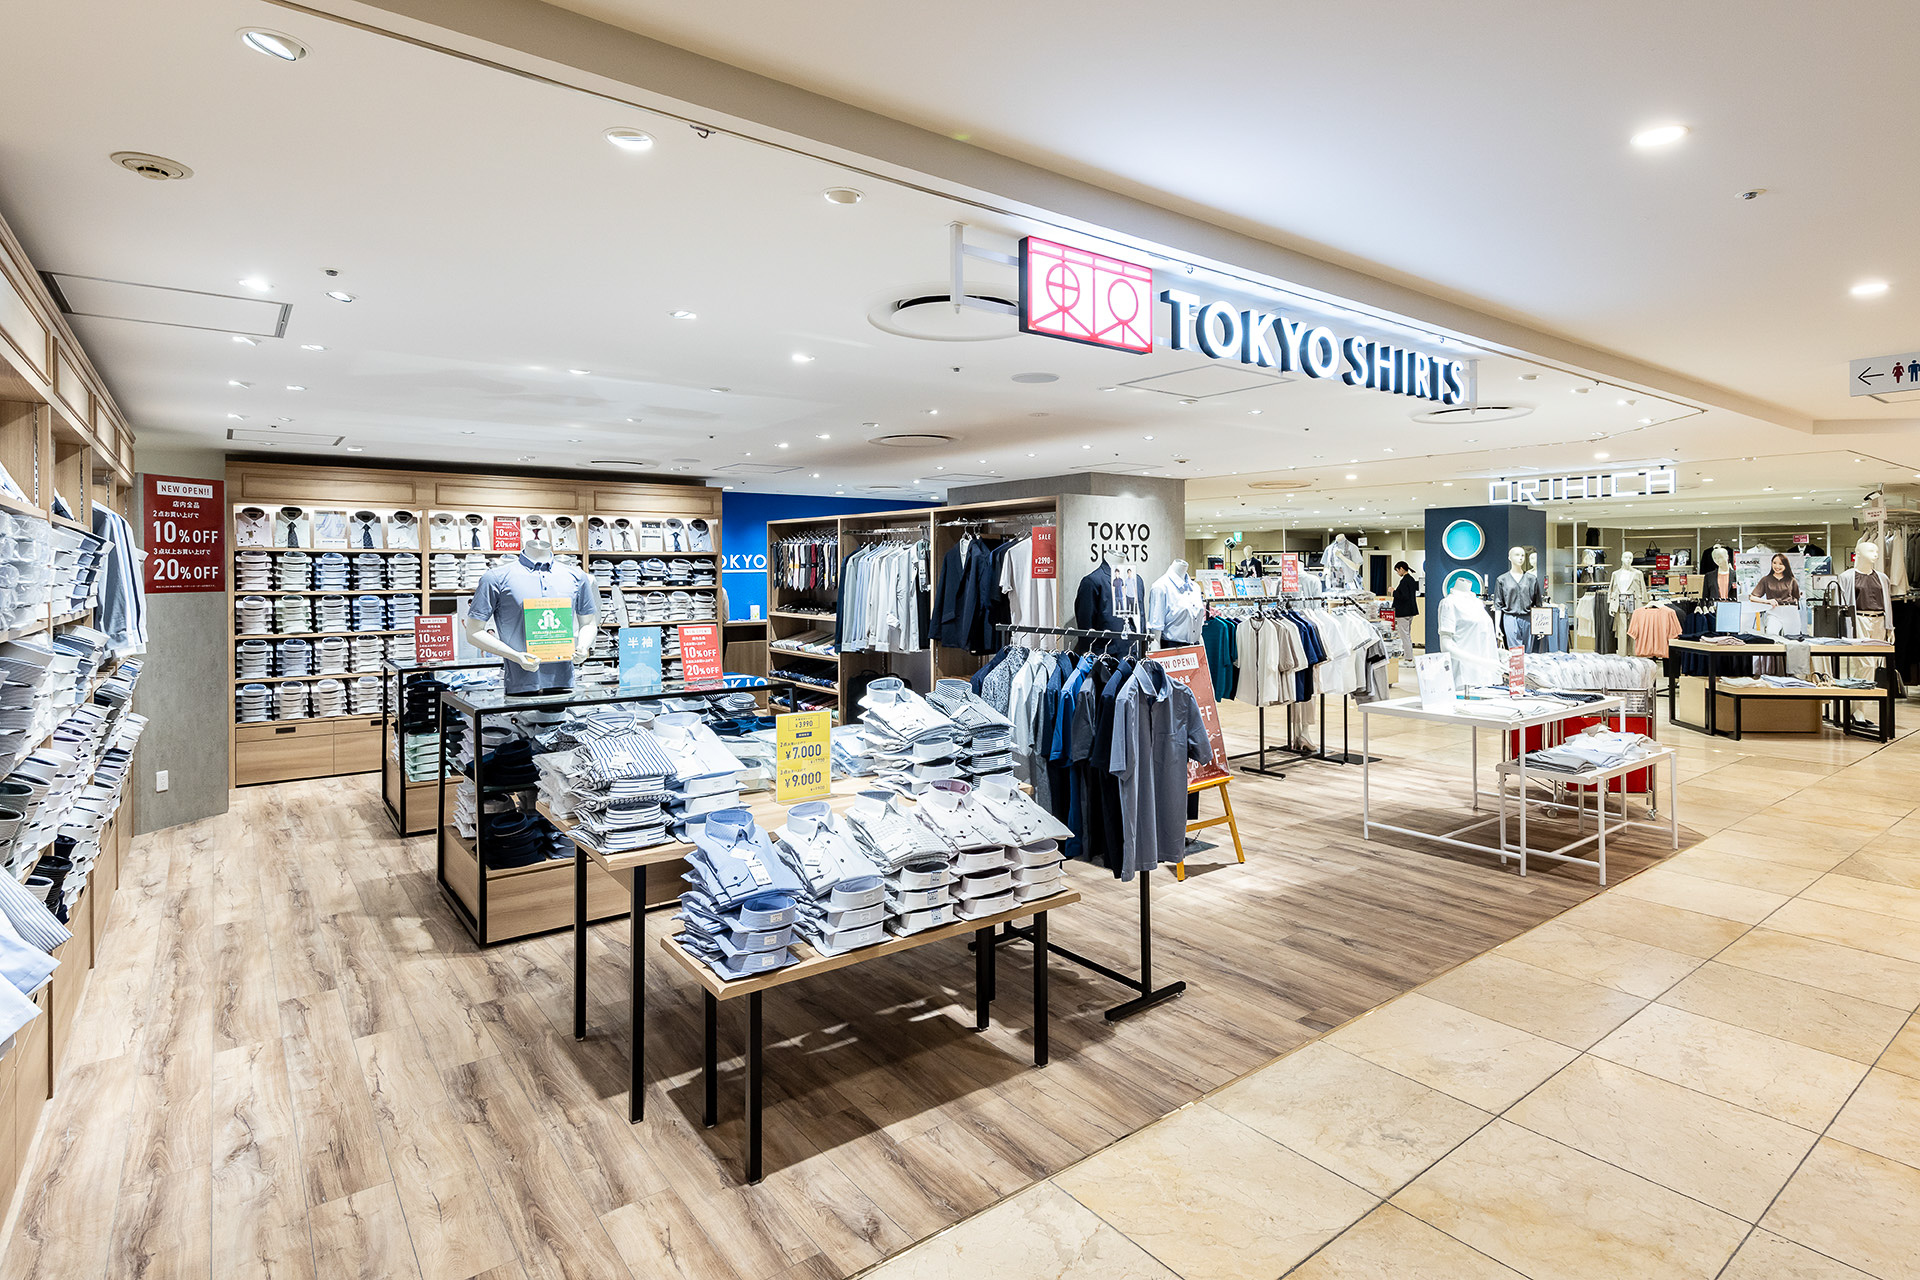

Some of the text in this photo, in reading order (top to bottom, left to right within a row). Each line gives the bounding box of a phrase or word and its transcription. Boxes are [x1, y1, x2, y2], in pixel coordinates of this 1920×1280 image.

[1160, 288, 1465, 405] TOKYO SHIRTS
[161, 485, 209, 495] NEW OPEN!!
[1489, 469, 1675, 505] ORIHICA
[172, 500, 200, 509] 店内全品
[1088, 522, 1150, 541] TOKYO
[627, 636, 653, 648] 半袖
[1172, 657, 1196, 668] OPEN!!
